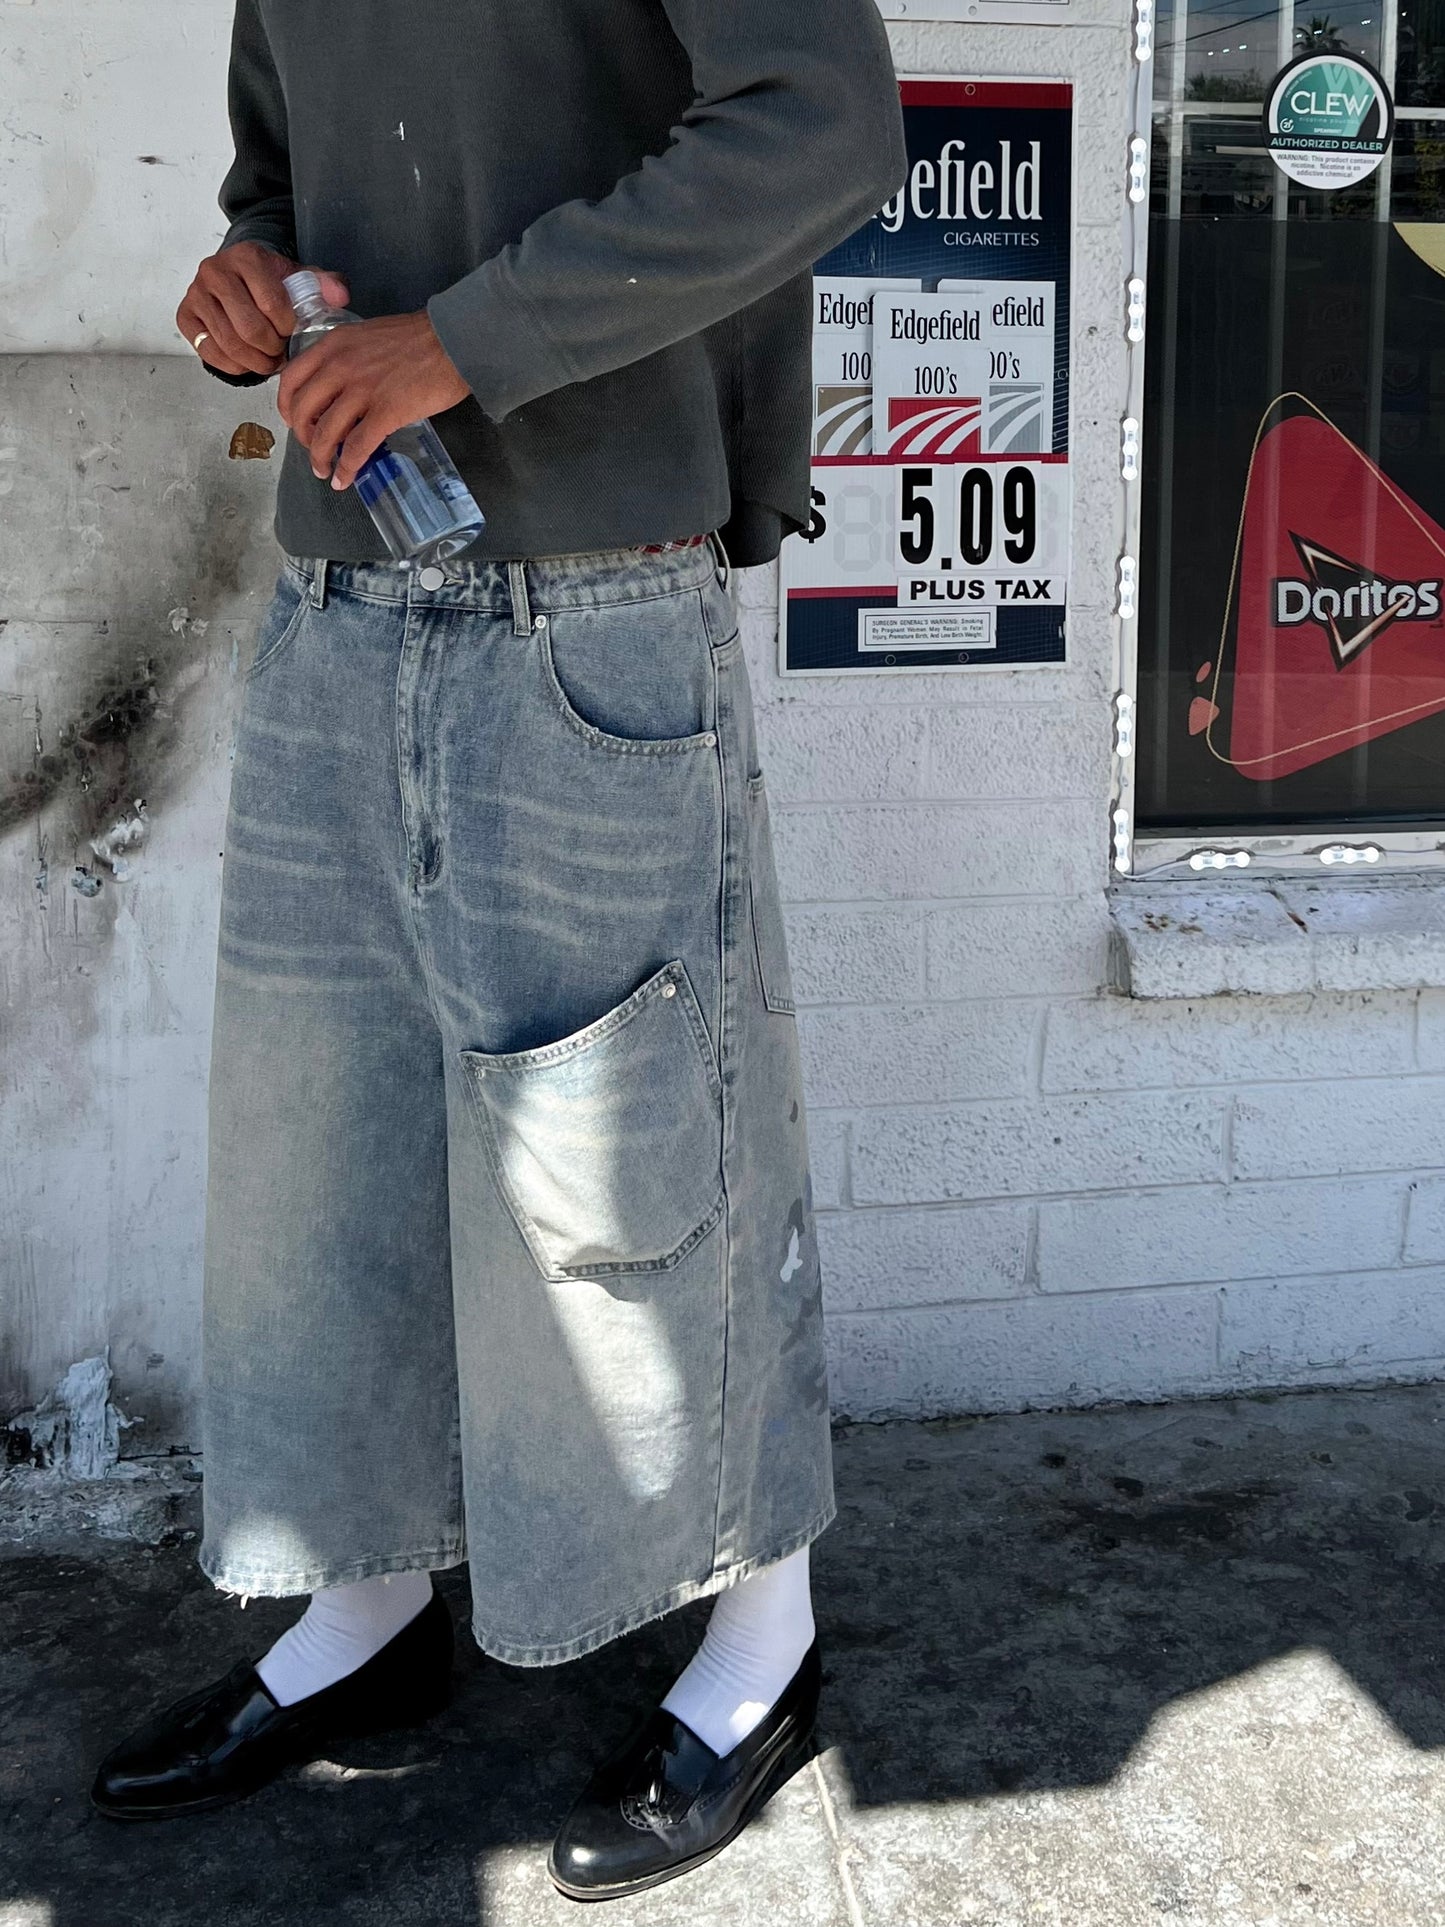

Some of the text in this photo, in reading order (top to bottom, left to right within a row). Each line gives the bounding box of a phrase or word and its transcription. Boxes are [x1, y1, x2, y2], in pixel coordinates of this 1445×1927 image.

[1290, 90, 1370, 116] CLEW
[1270, 137, 1383, 151] AUTHORIZED DEALER
[1325, 156, 1349, 164] product
[872, 139, 1043, 233] gefield
[943, 231, 1040, 246] CIGARETTES
[890, 308, 981, 344] Edgefield
[914, 366, 958, 395] 100's
[798, 465, 1036, 570] $ 5.09
[910, 579, 1052, 601] PLUS TAX
[1277, 579, 1439, 623] Doritos
